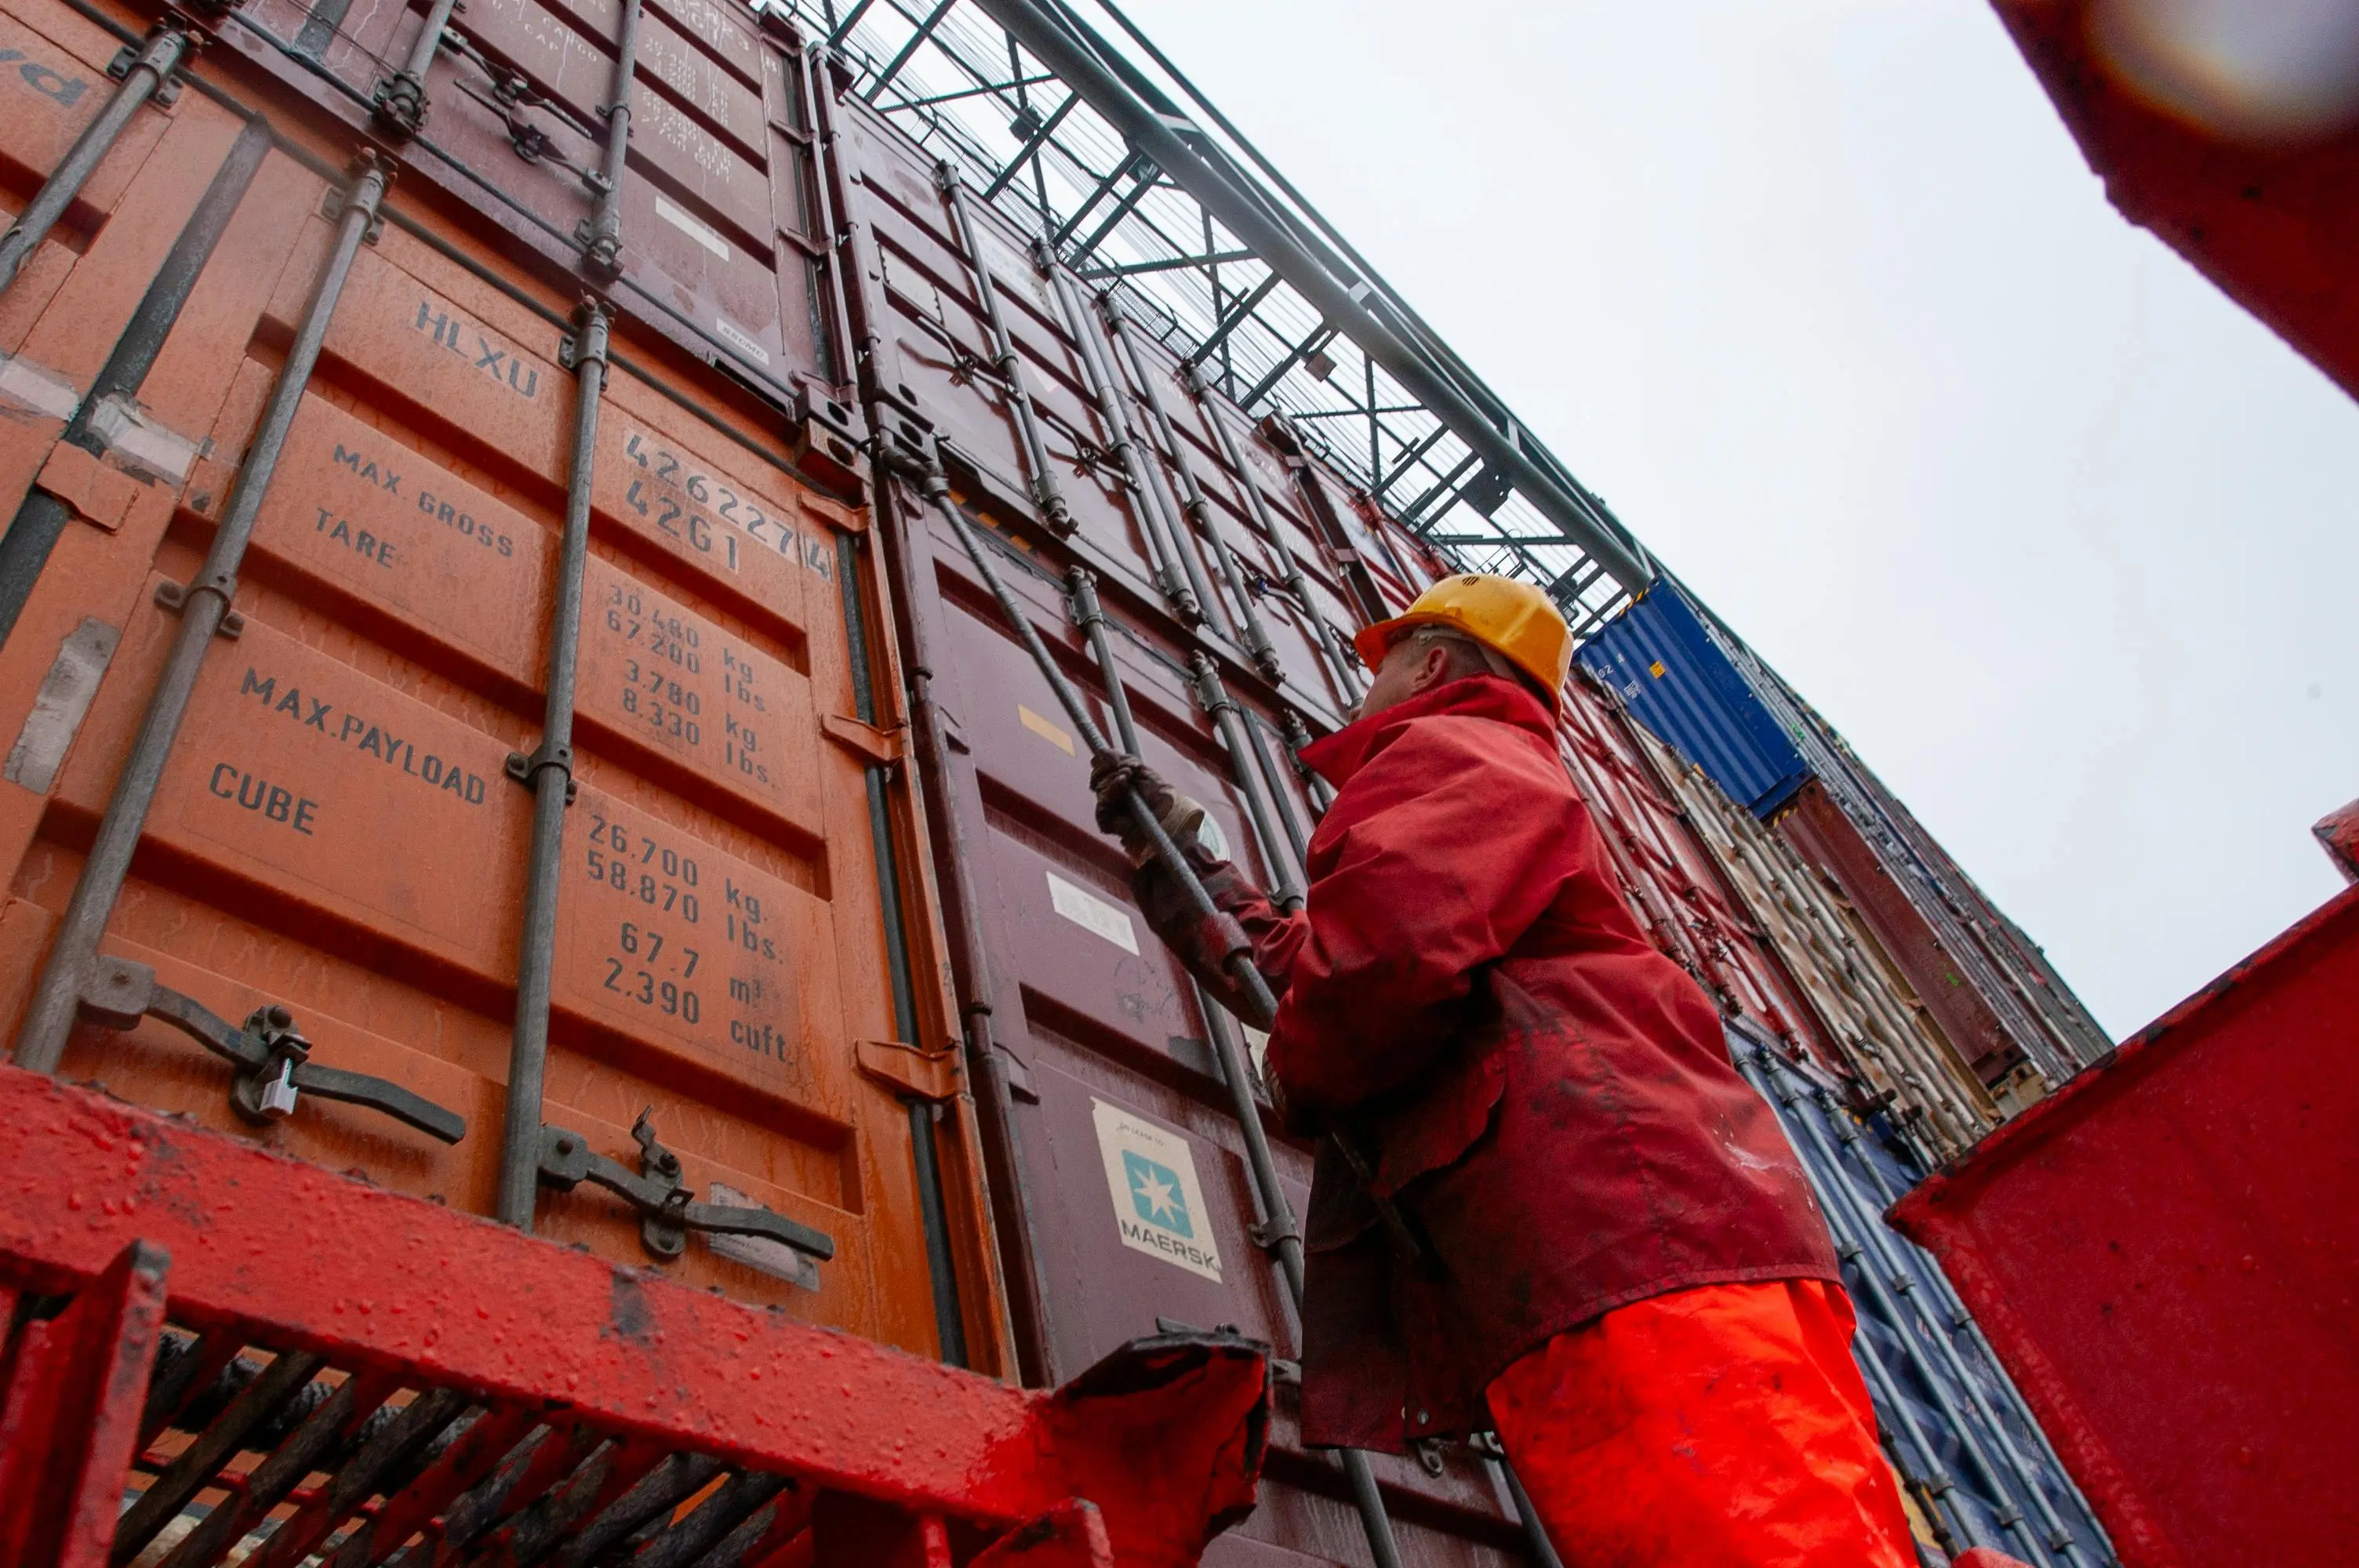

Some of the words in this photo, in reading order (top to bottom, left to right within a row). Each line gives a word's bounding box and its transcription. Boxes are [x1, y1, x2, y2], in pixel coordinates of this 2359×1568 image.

[416, 301, 537, 397] HLXU
[627, 434, 793, 554] 426227
[627, 479, 737, 571] 42G1
[419, 492, 513, 557] GROSS
[609, 584, 698, 648] 30.480
[316, 507, 396, 569] TARE
[626, 659, 700, 716] 3.780
[607, 610, 700, 674] 67.200
[623, 688, 700, 746] 8.330
[209, 763, 318, 836] CUBE
[621, 922, 699, 978] 67.7
[588, 849, 699, 924] 58.870
[589, 815, 698, 887] 26.700
[604, 957, 700, 1024] 2.390
[1121, 1219, 1220, 1271] MAERSK
